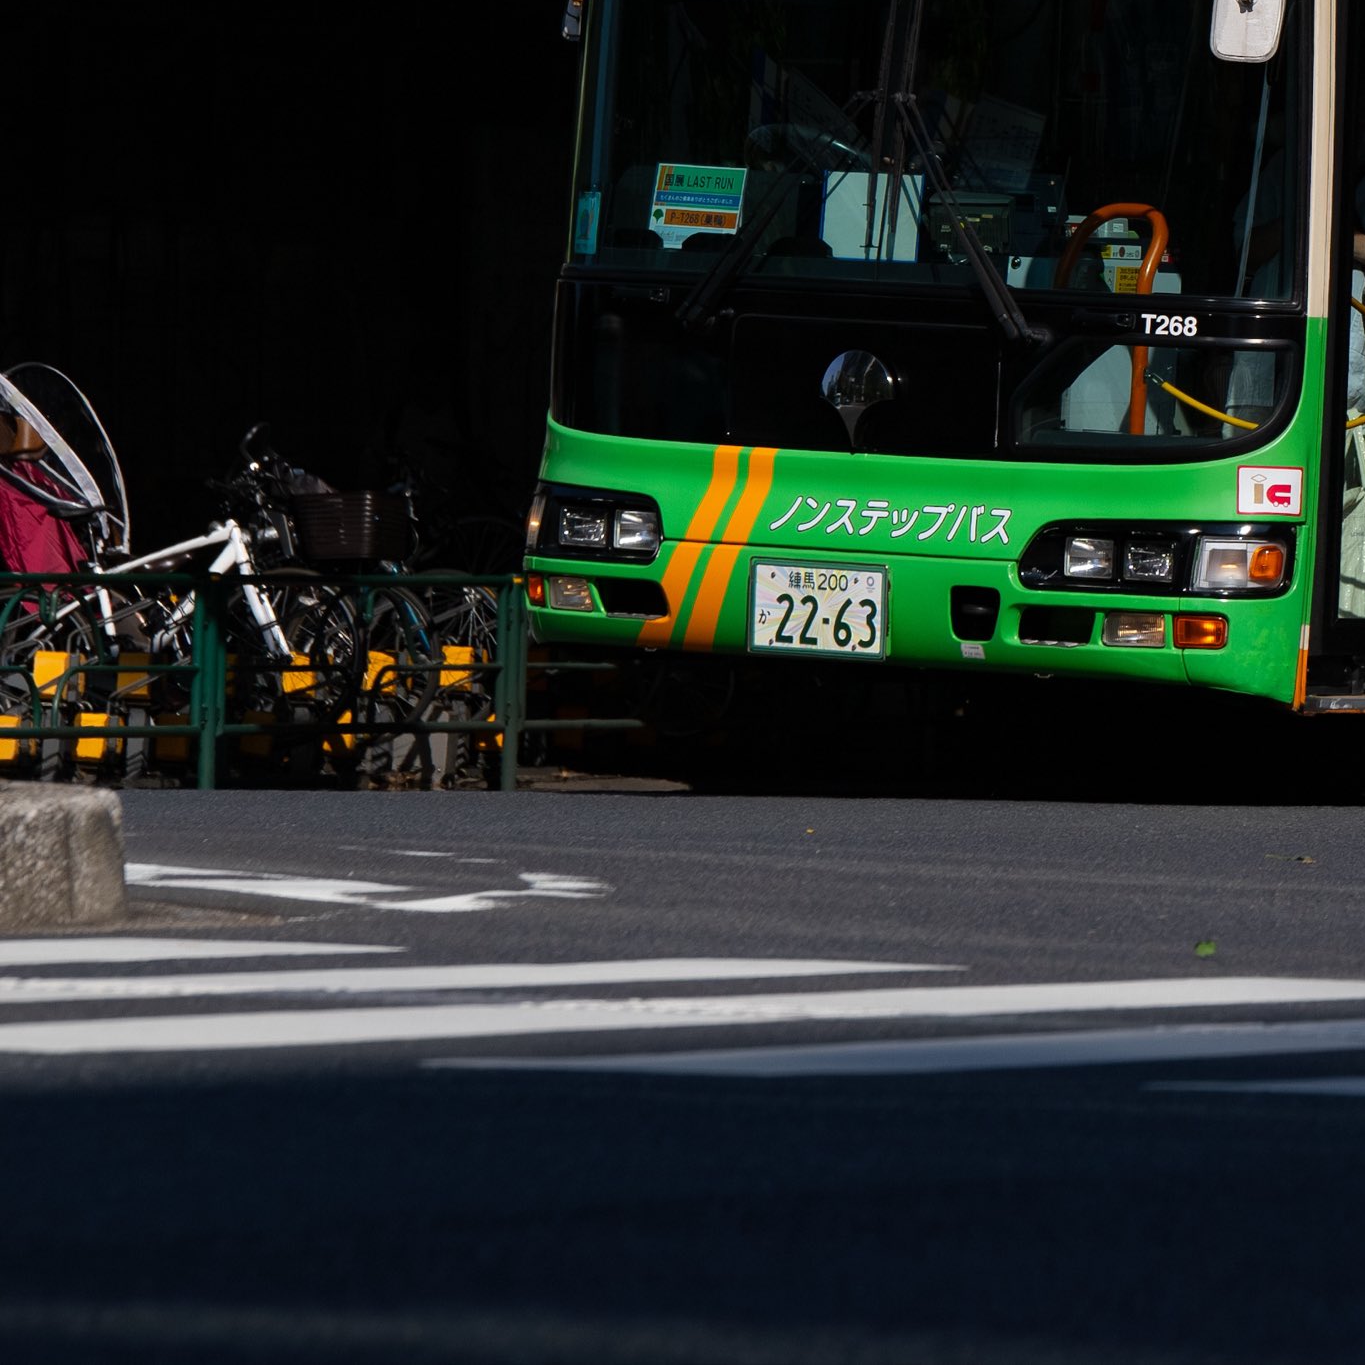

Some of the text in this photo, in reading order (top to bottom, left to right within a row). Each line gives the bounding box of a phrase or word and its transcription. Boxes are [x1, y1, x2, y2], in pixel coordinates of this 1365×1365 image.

[687, 175, 712, 188] LAST
[714, 177, 735, 190] RUN
[1141, 313, 1198, 337] T268
[769, 496, 1012, 545] ノンステップバス
[758, 609, 771, 625] か
[774, 593, 878, 649] 22-63
